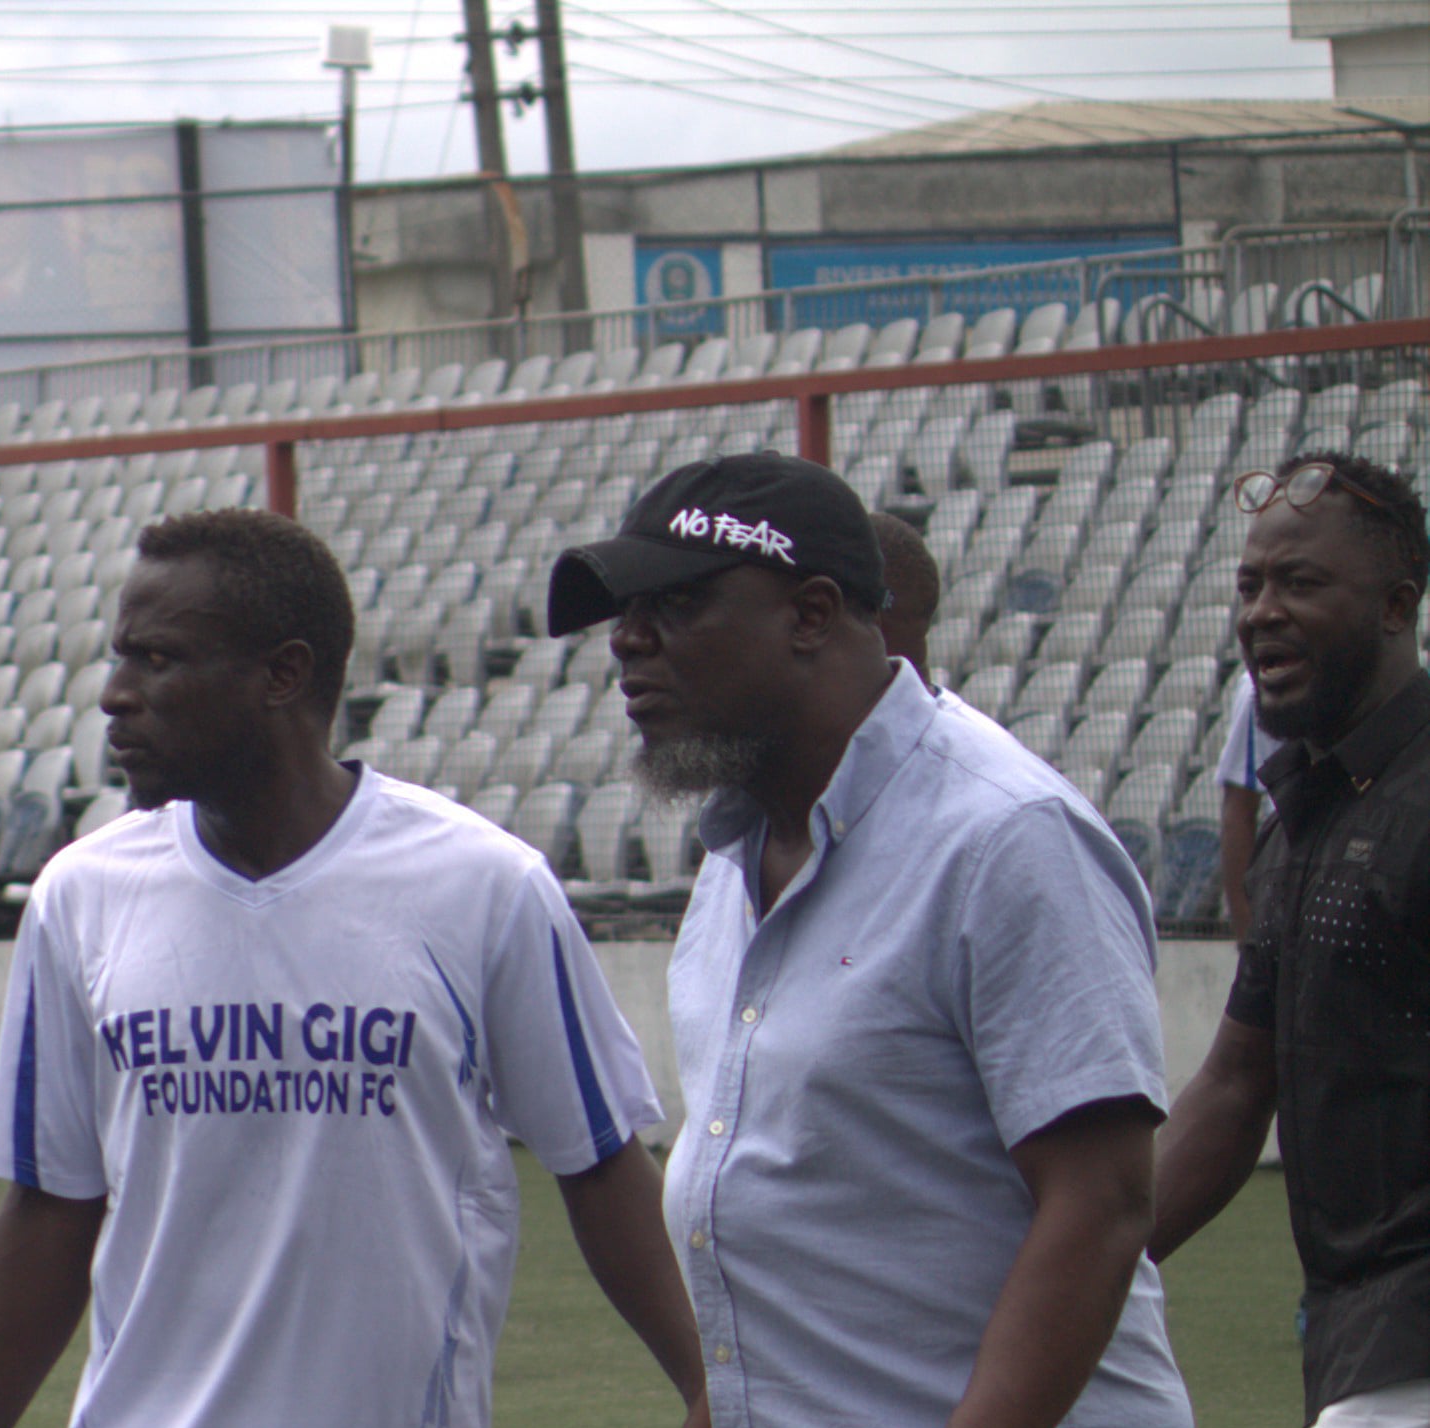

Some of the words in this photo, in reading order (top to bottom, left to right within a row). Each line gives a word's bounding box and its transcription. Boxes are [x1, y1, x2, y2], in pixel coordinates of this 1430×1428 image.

[669, 507, 710, 540] NO
[713, 513, 796, 565] FEAR
[101, 1002, 284, 1073] KELVIN
[302, 1002, 417, 1068] GIGI
[142, 1069, 350, 1117] FOUNDATION
[360, 1072, 396, 1117] FC
